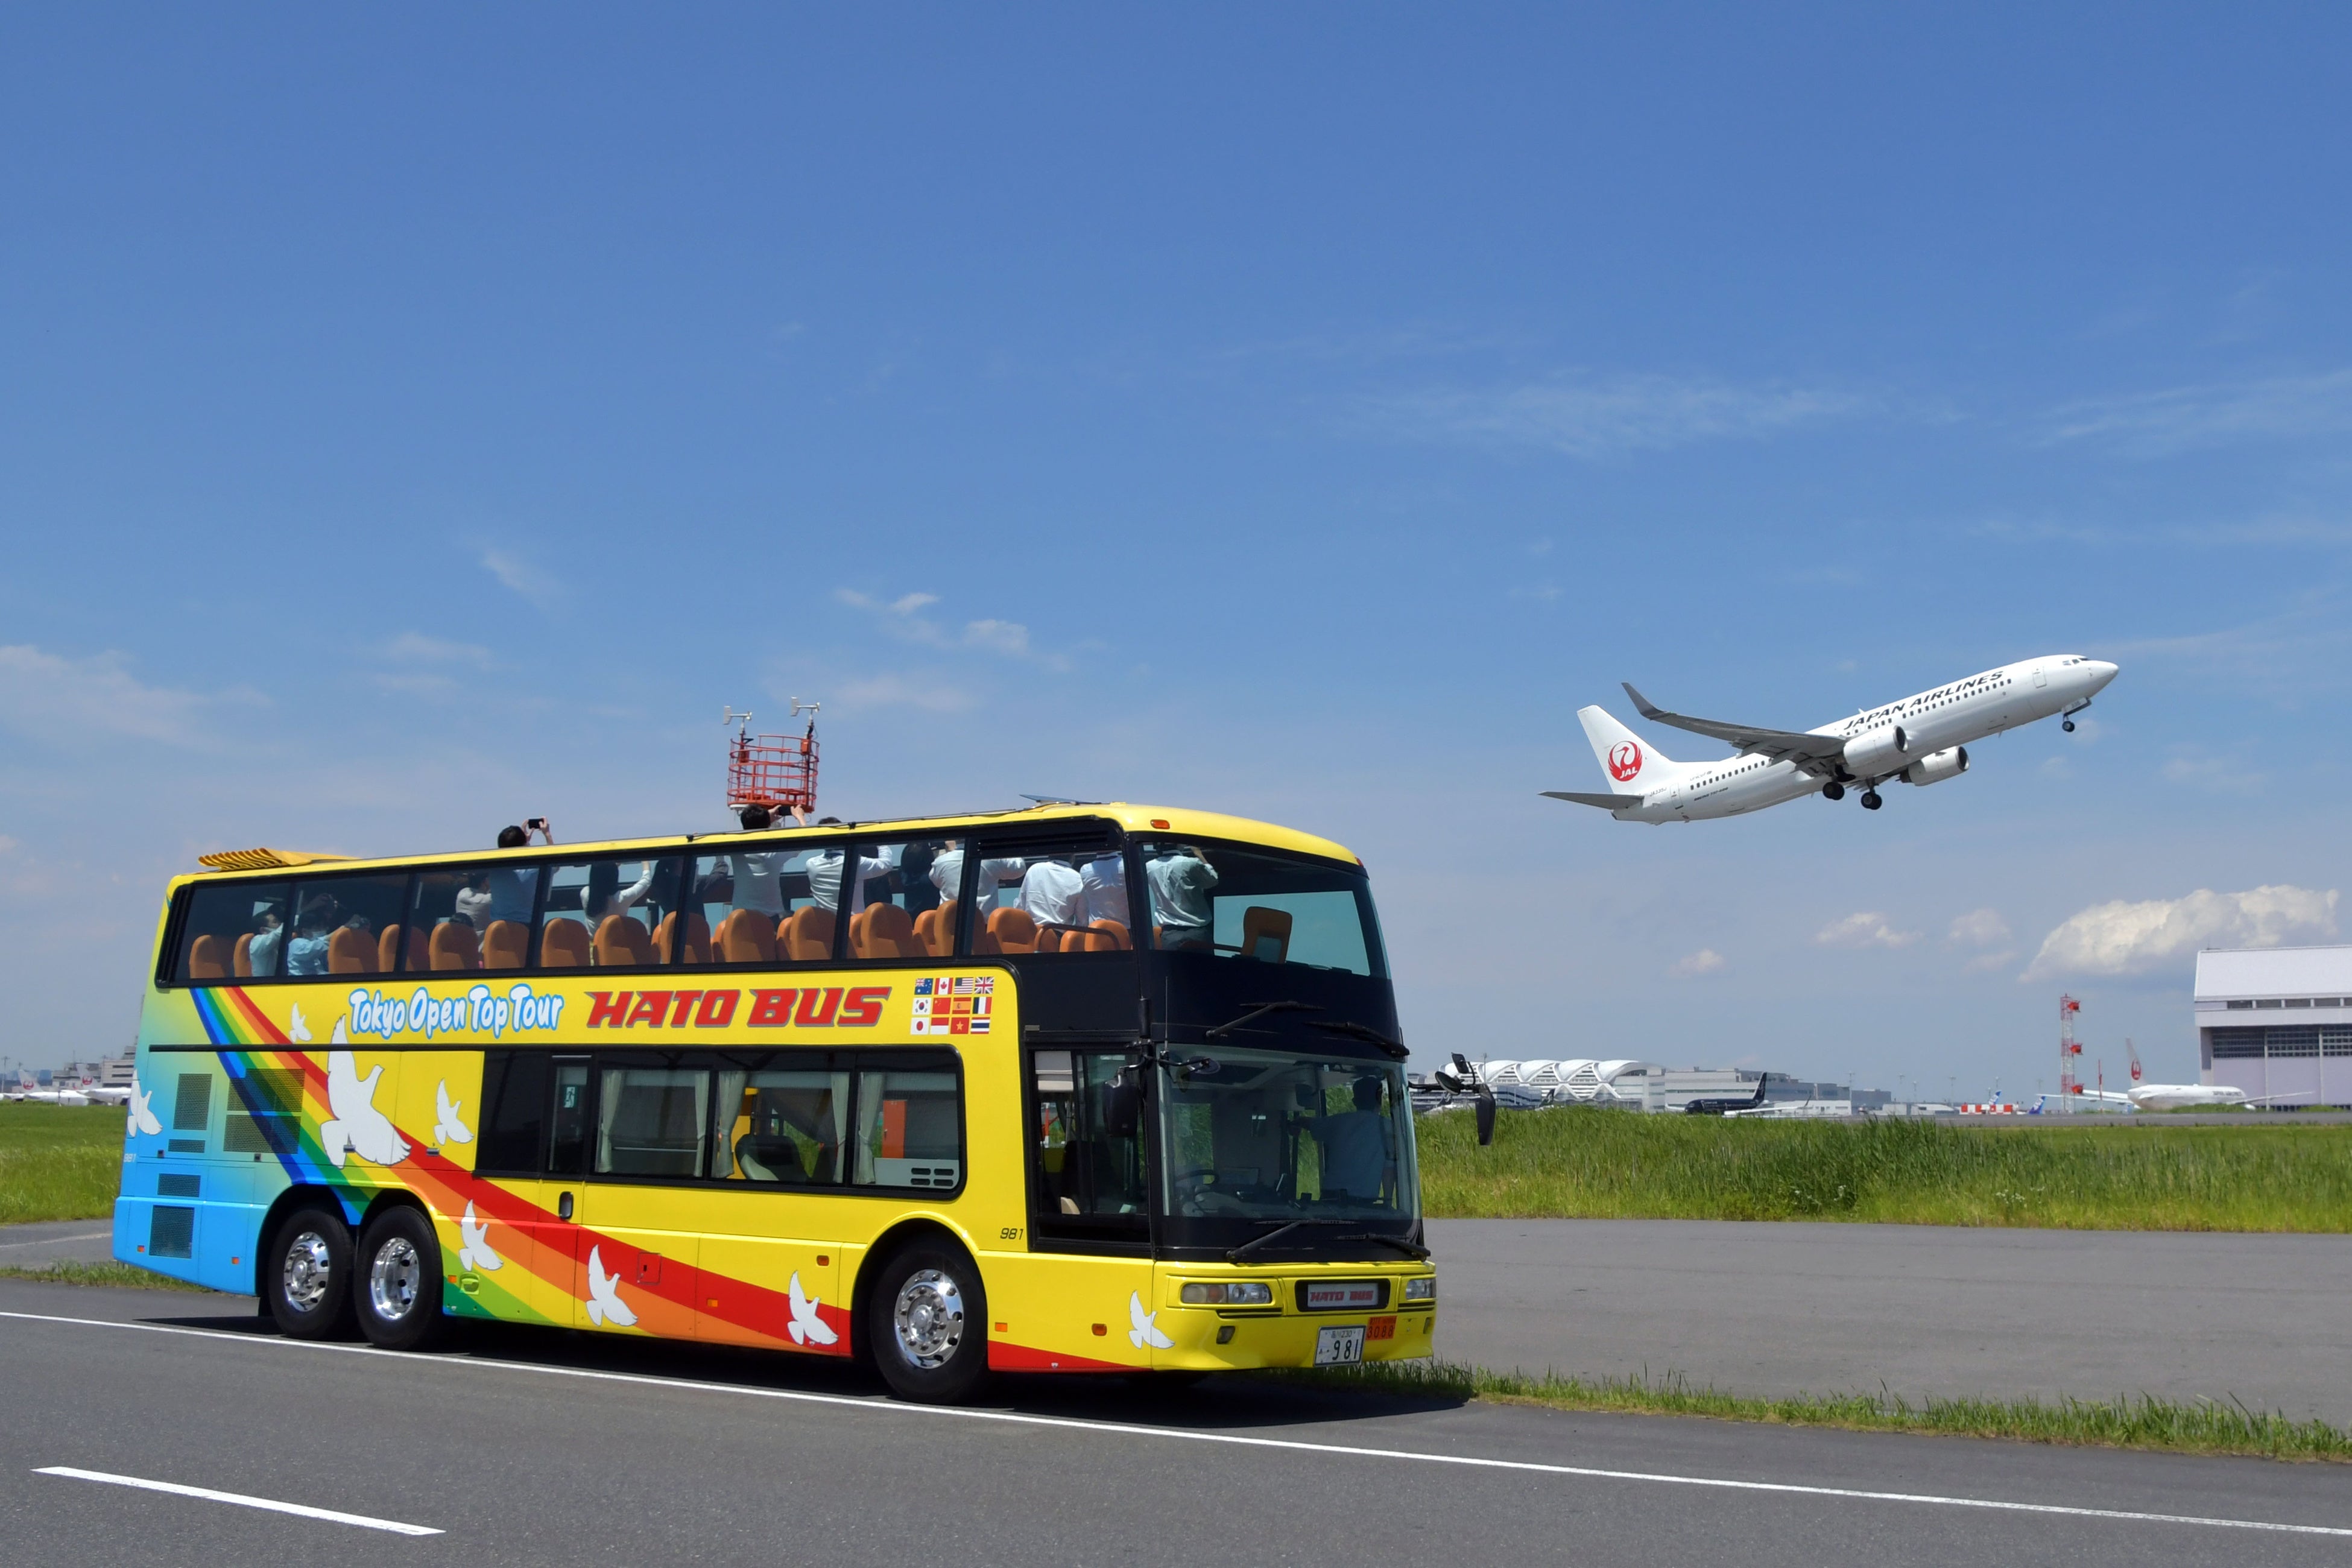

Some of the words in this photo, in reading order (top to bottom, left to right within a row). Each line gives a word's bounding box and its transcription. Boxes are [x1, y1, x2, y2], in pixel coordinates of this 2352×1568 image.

[1844, 703, 1906, 730] JAPAN
[1910, 671, 2004, 708] AIRLINES
[1620, 766, 1638, 779] JAL
[349, 988, 406, 1040] Tokyo
[408, 986, 467, 1039] Open
[469, 984, 508, 1039] Top
[509, 983, 564, 1032] Tour
[584, 989, 741, 1028] HATO
[747, 986, 893, 1027] BUS
[1000, 1227, 1024, 1241] 981
[1332, 1339, 1359, 1360] 981
